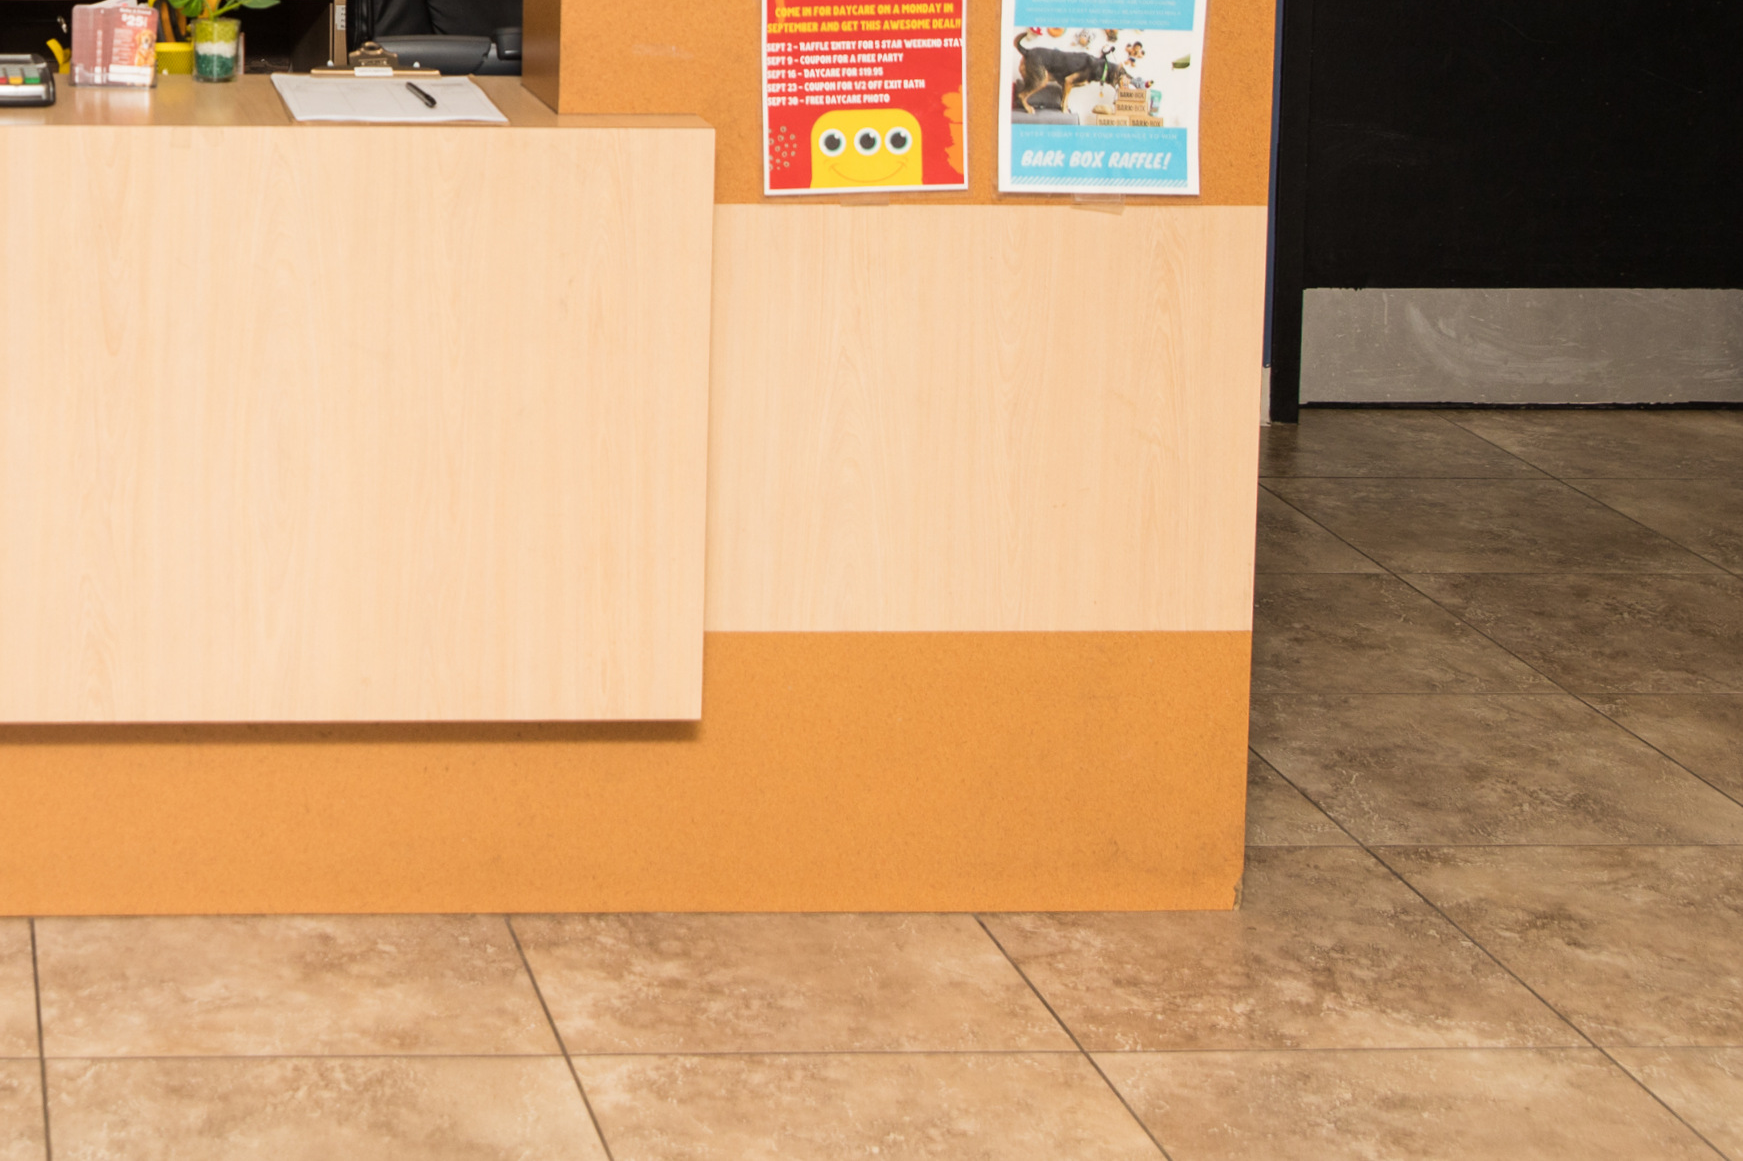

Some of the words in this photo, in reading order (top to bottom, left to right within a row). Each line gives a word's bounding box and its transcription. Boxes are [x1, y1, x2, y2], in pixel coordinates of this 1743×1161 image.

[775, 6, 800, 17] COME
[802, 6, 811, 17] IN
[813, 6, 831, 16] FOR
[833, 5, 875, 16] DAYCARE
[878, 5, 889, 15] ON
[893, 4, 900, 15] A
[902, 4, 941, 14] MONDAY
[944, 3, 953, 13] IN
[767, 22, 818, 34] SEPTEMBER
[820, 22, 839, 32] AND
[841, 21, 858, 32] GET
[861, 20, 881, 31] THIS
[884, 19, 930, 30] AWESOME
[1069, 151, 1104, 168] BOX
[1108, 152, 1171, 170] RAFFLE!
